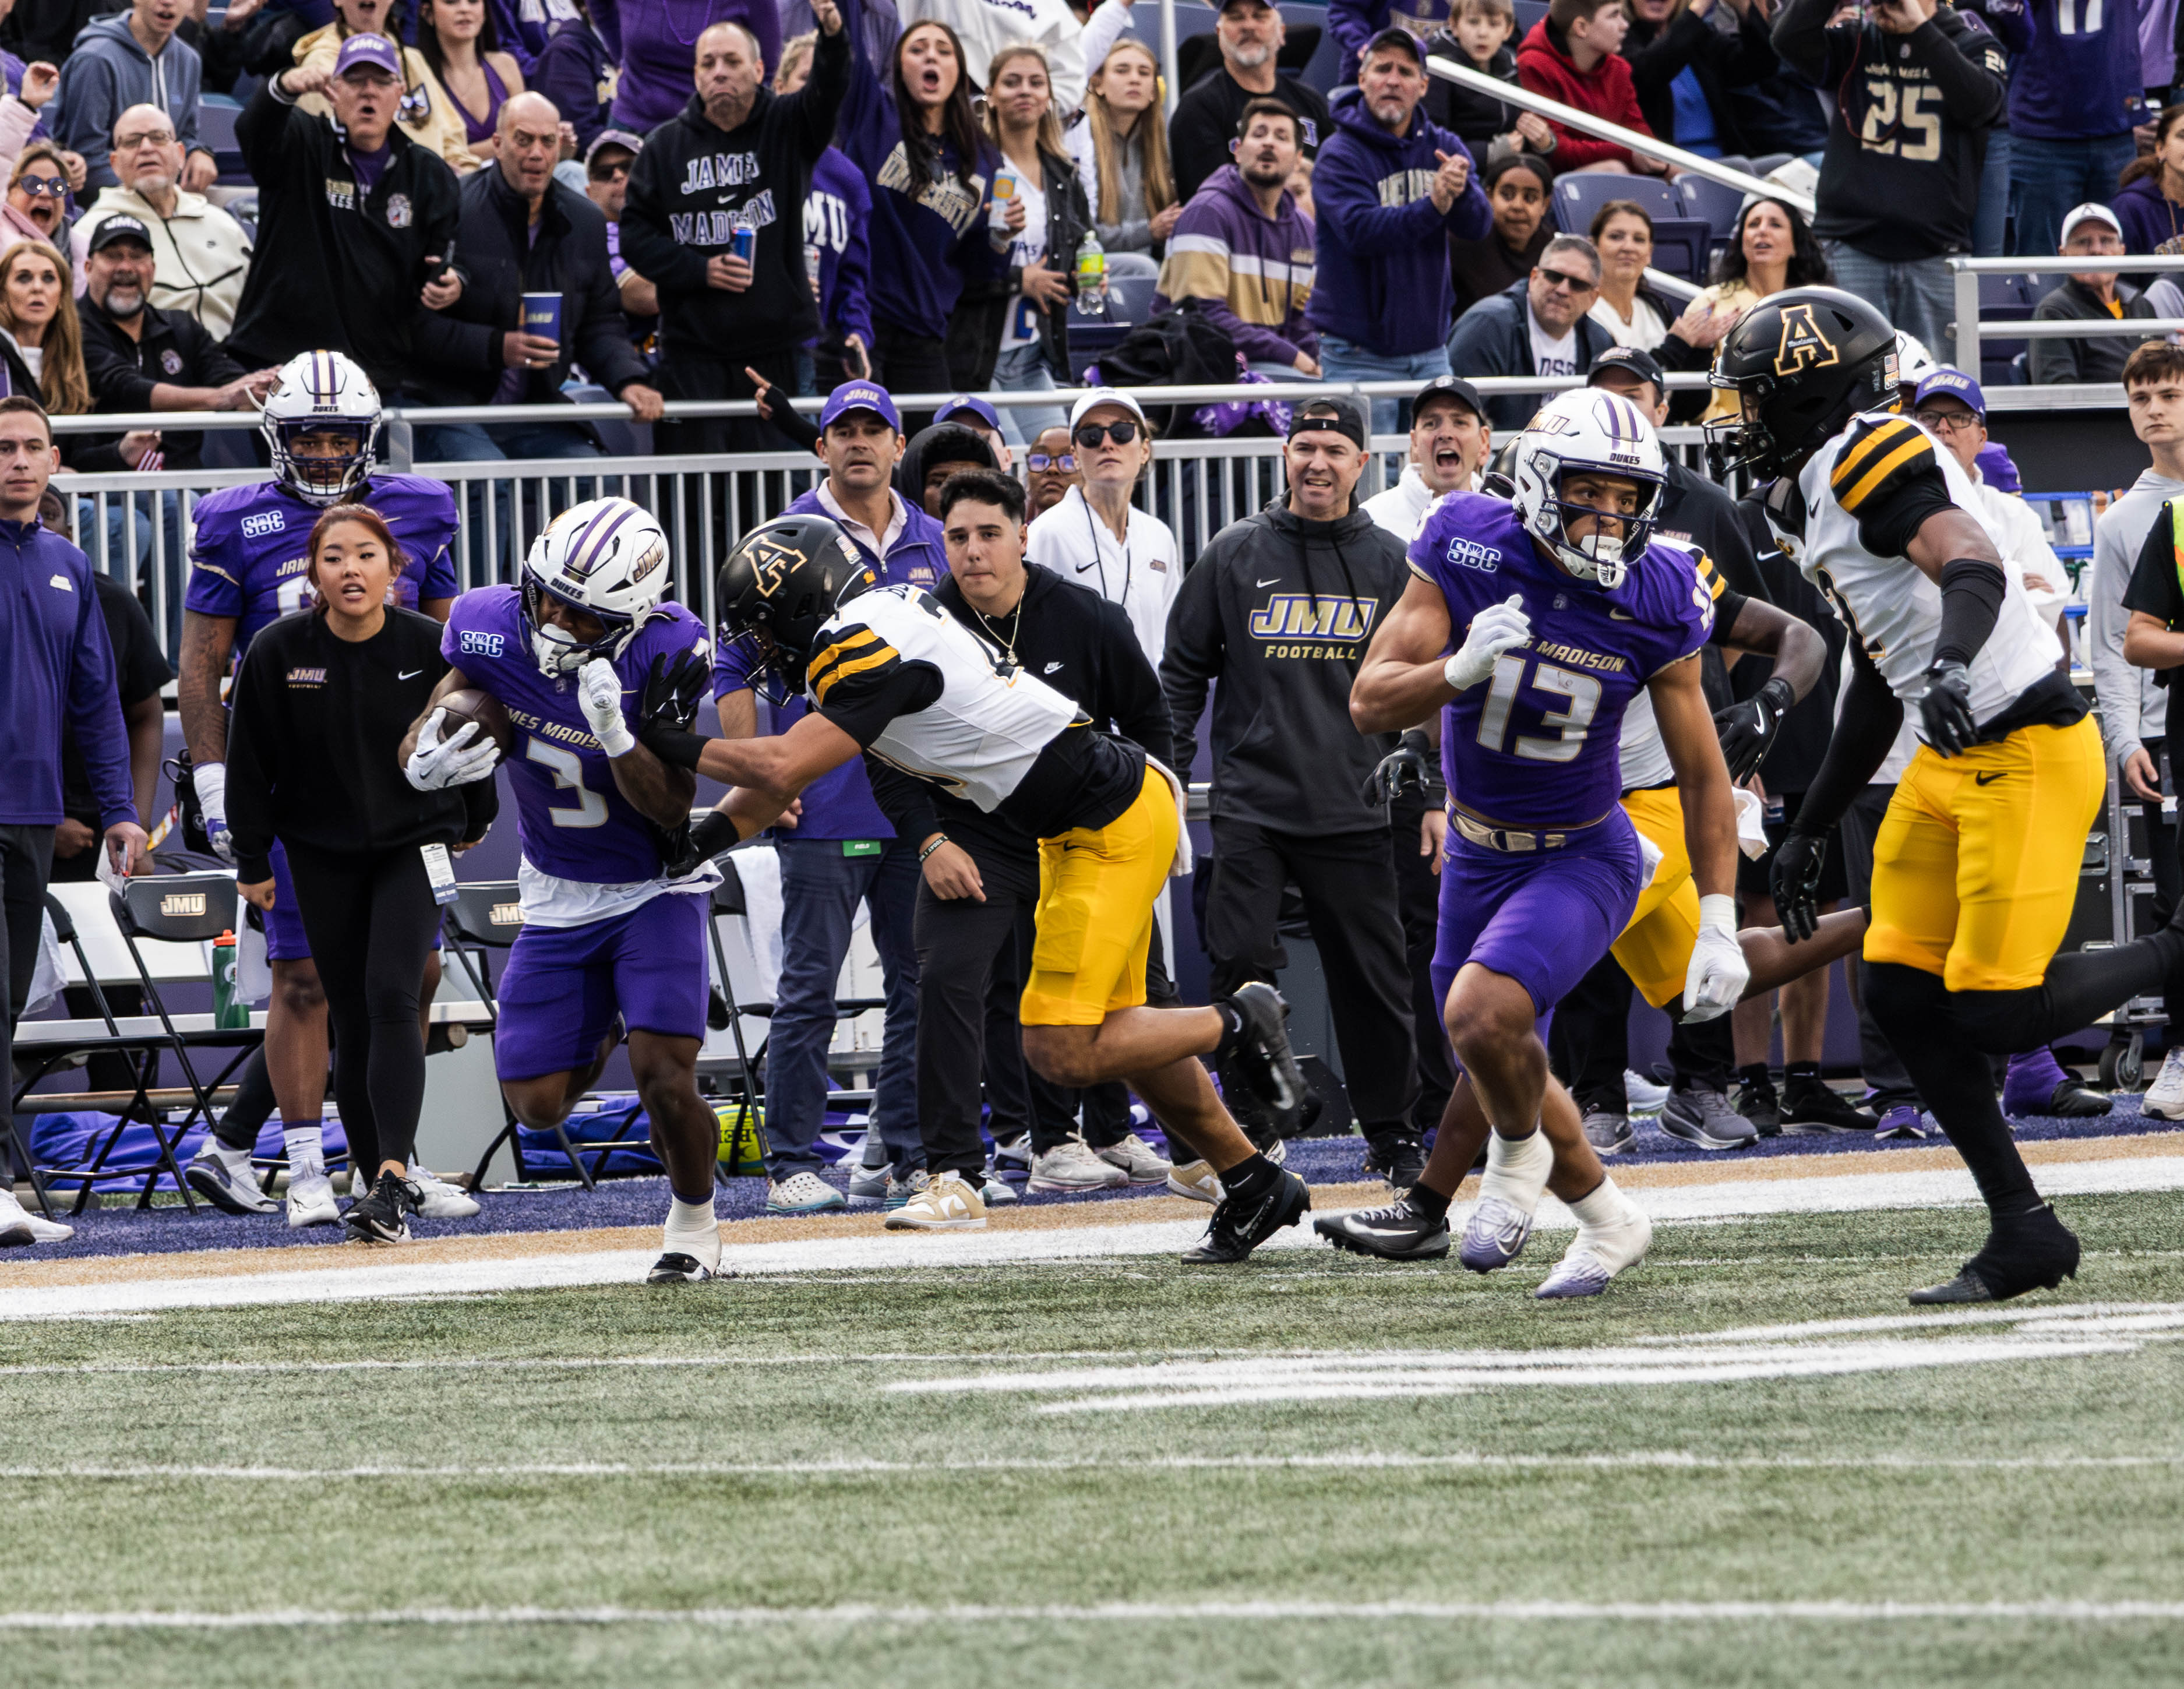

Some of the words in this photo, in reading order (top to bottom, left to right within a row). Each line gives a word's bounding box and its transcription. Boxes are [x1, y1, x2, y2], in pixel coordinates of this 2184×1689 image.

[1862, 82, 1943, 161] 25
[803, 191, 847, 253] MU
[1774, 304, 1840, 376] A
[843, 389, 880, 403] JMU
[1924, 373, 1971, 391] JMU
[1609, 453, 1640, 465] DUKES
[241, 510, 286, 538] SBC
[276, 556, 312, 577] JAM
[633, 539, 664, 583] JMU
[1446, 537, 1502, 573] SBC
[550, 577, 585, 600] DUKES
[1248, 593, 1379, 643] JMU
[460, 630, 505, 658] SBC
[1264, 645, 1358, 660] FOOTBALL
[1536, 640, 1626, 672] MADISON
[286, 667, 327, 683] JMU
[508, 707, 542, 730] MES
[1476, 654, 1602, 763] 13
[525, 735, 609, 828] 3
[160, 893, 206, 916] JMU
